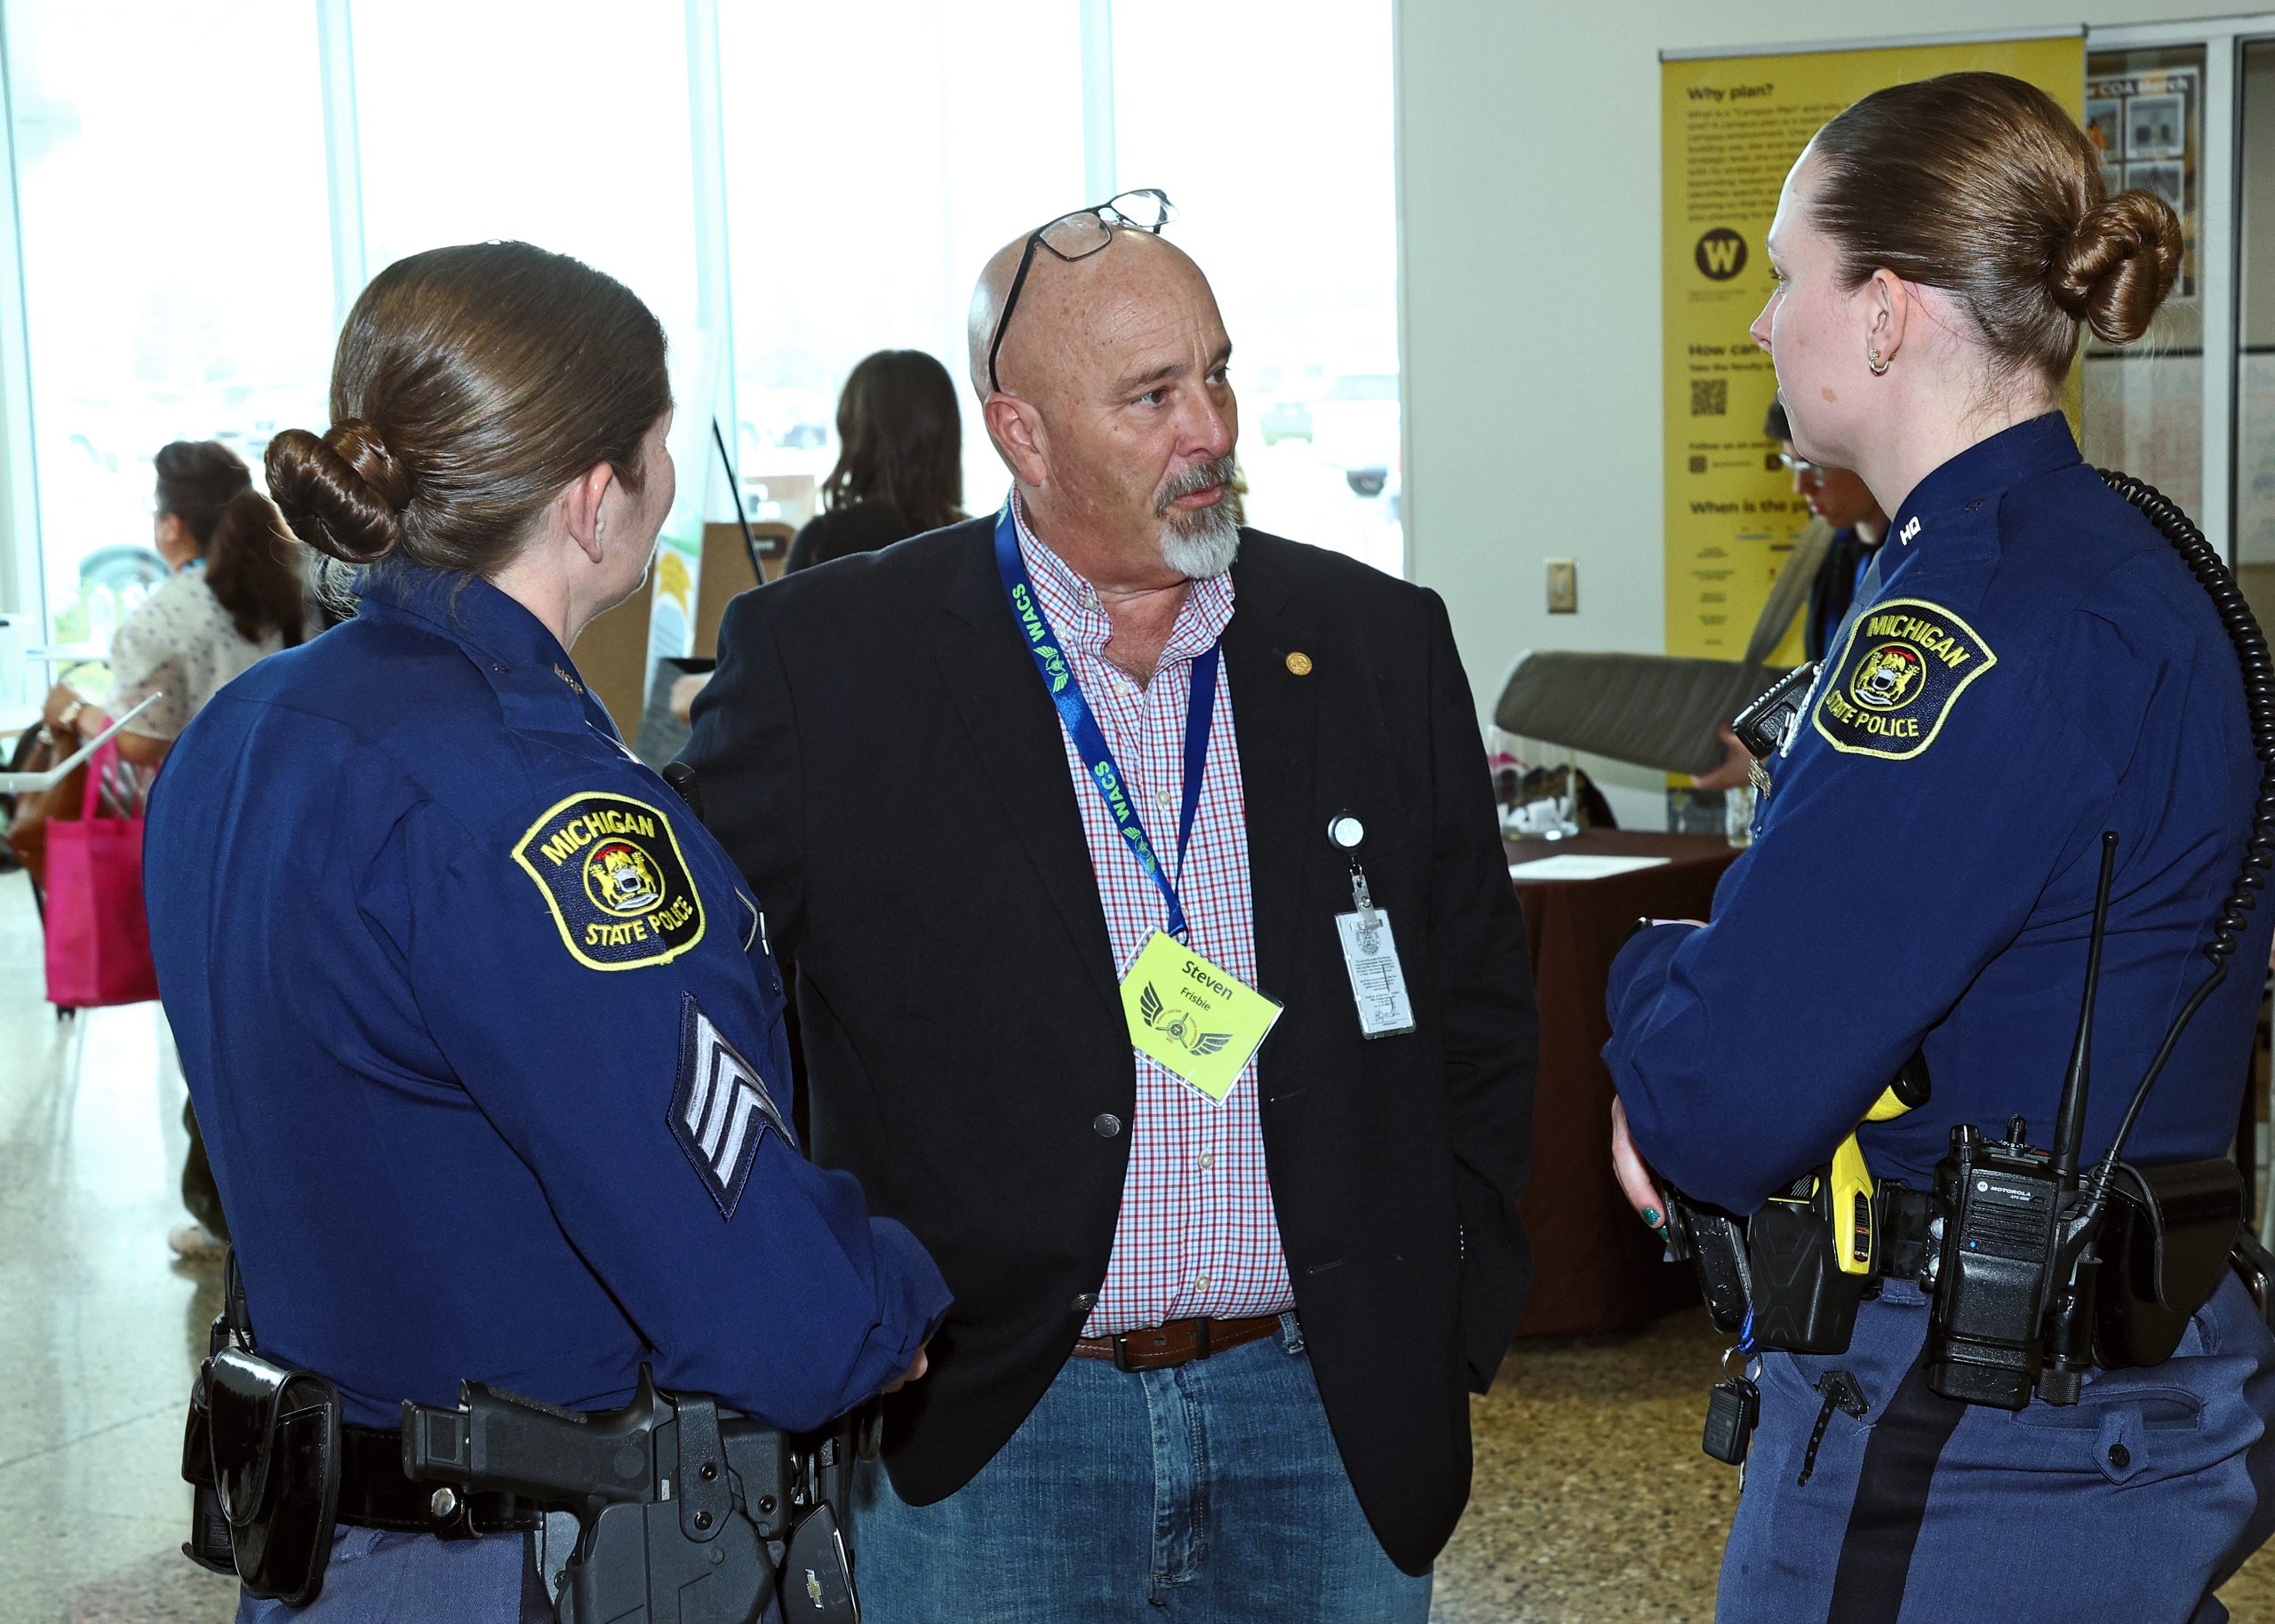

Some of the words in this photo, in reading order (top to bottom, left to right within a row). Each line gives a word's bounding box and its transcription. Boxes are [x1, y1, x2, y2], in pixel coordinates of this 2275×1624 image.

[1688, 87, 1725, 102] Why
[1728, 83, 1774, 100] plan?
[1704, 239, 1740, 273] W
[1688, 344, 1726, 355] How
[1730, 343, 1760, 355] can
[1689, 501, 1739, 513] When
[1743, 499, 1757, 513] is
[1760, 498, 1788, 513] the
[1899, 516, 1921, 546] HQ
[1012, 582, 1046, 642] WACS
[1866, 615, 1970, 669] MICHIGAN
[1825, 689, 1857, 723] STATE
[1855, 712, 1920, 737] POLICE
[1094, 760, 1131, 823] WACS
[539, 809, 655, 866] MICHIGAN
[585, 919, 648, 947] STATE
[647, 895, 693, 934] POLICE
[1181, 960, 1233, 1000] Steven
[1180, 987, 1211, 1011] Frisbie
[1990, 1186, 2032, 1197] MOTOROLA
